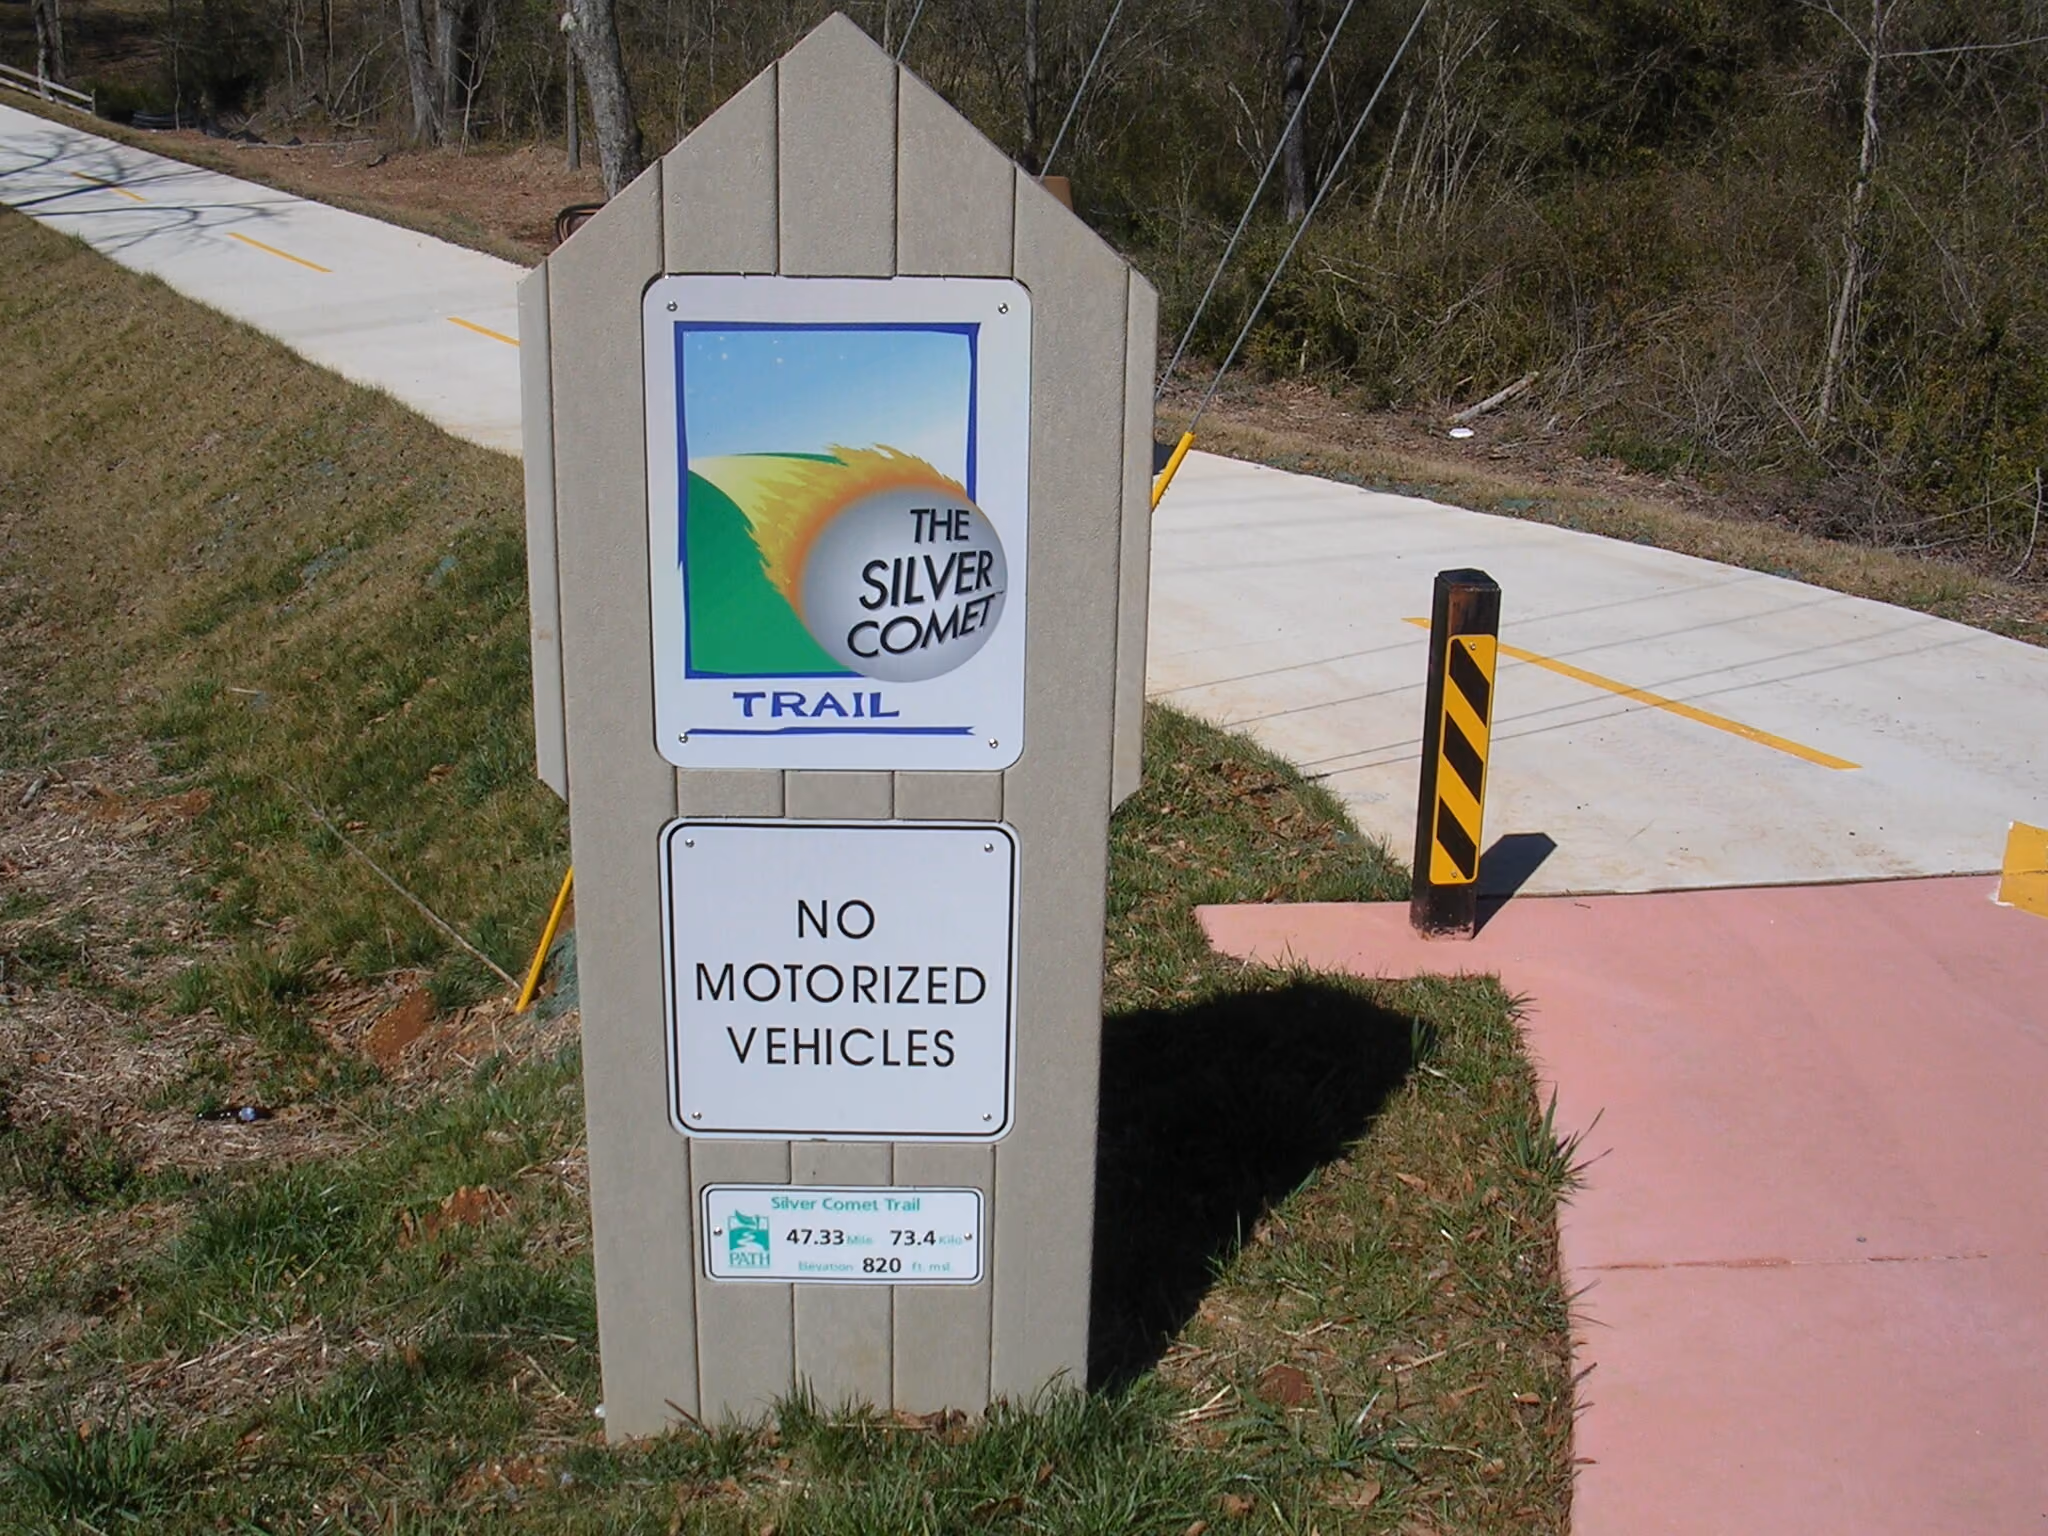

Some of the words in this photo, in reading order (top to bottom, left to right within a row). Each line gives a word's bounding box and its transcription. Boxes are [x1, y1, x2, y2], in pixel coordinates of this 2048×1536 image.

[910, 508, 970, 544] THE
[859, 550, 994, 610] SILVER
[847, 590, 997, 658] COMET
[732, 691, 900, 718] TRAIL
[797, 899, 875, 939] NO
[695, 962, 987, 1004] MOTORIZED
[726, 1026, 955, 1067] VEHICLES
[770, 1196, 817, 1211] Silver
[822, 1197, 879, 1211] Comet
[885, 1198, 920, 1212] Trail
[786, 1228, 845, 1246] 47.33
[890, 1230, 937, 1246] 73.4
[729, 1252, 771, 1266] PATH
[862, 1258, 902, 1274] 820
